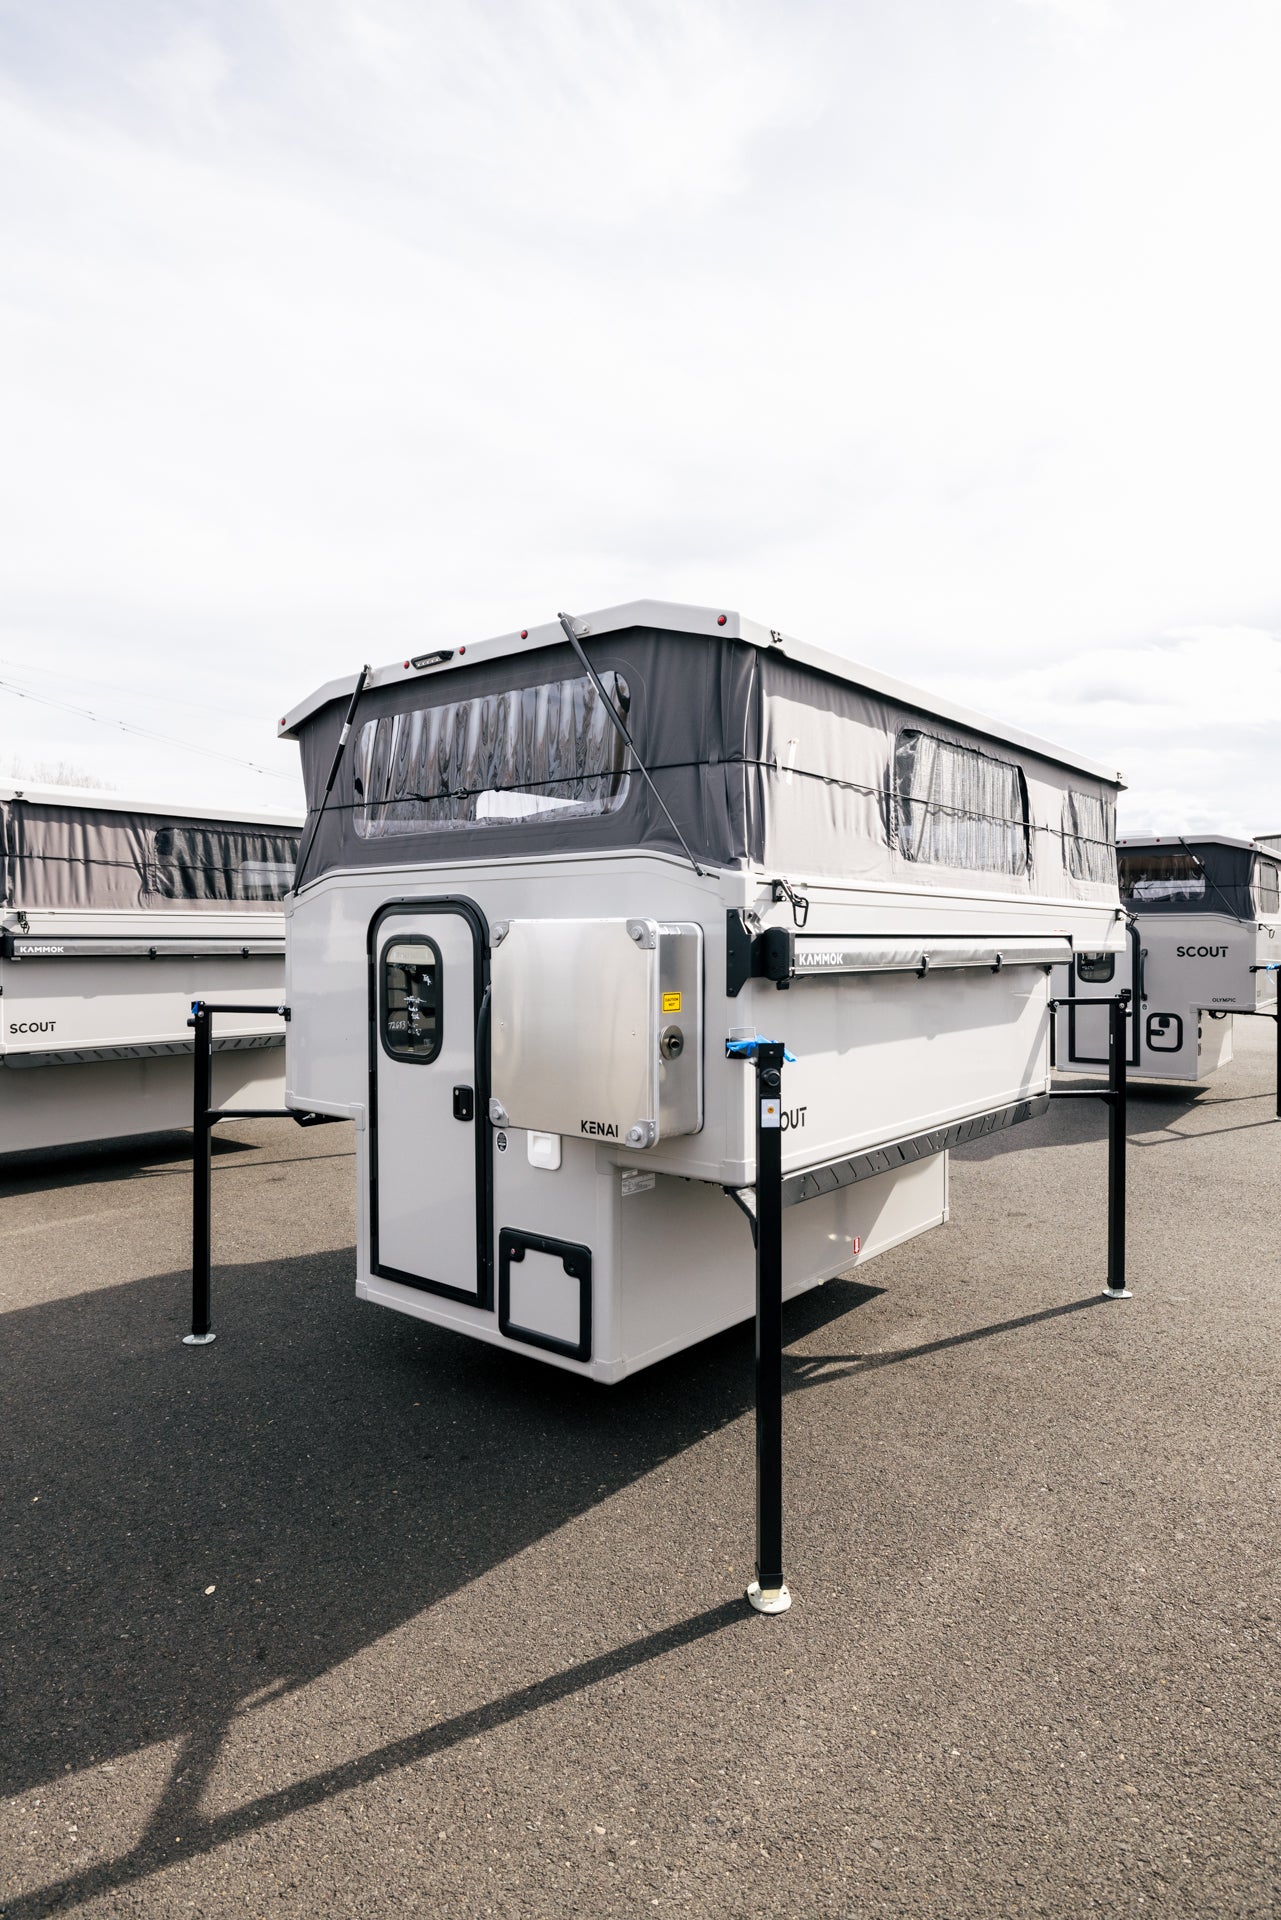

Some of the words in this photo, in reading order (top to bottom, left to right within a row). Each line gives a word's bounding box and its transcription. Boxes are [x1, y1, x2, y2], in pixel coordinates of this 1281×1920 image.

[1176, 946, 1229, 958] SCOUT
[799, 953, 844, 966] KAMMOK
[9, 1021, 56, 1034] SCOUT
[780, 1106, 807, 1131] OUT
[581, 1120, 619, 1138] KENAI
